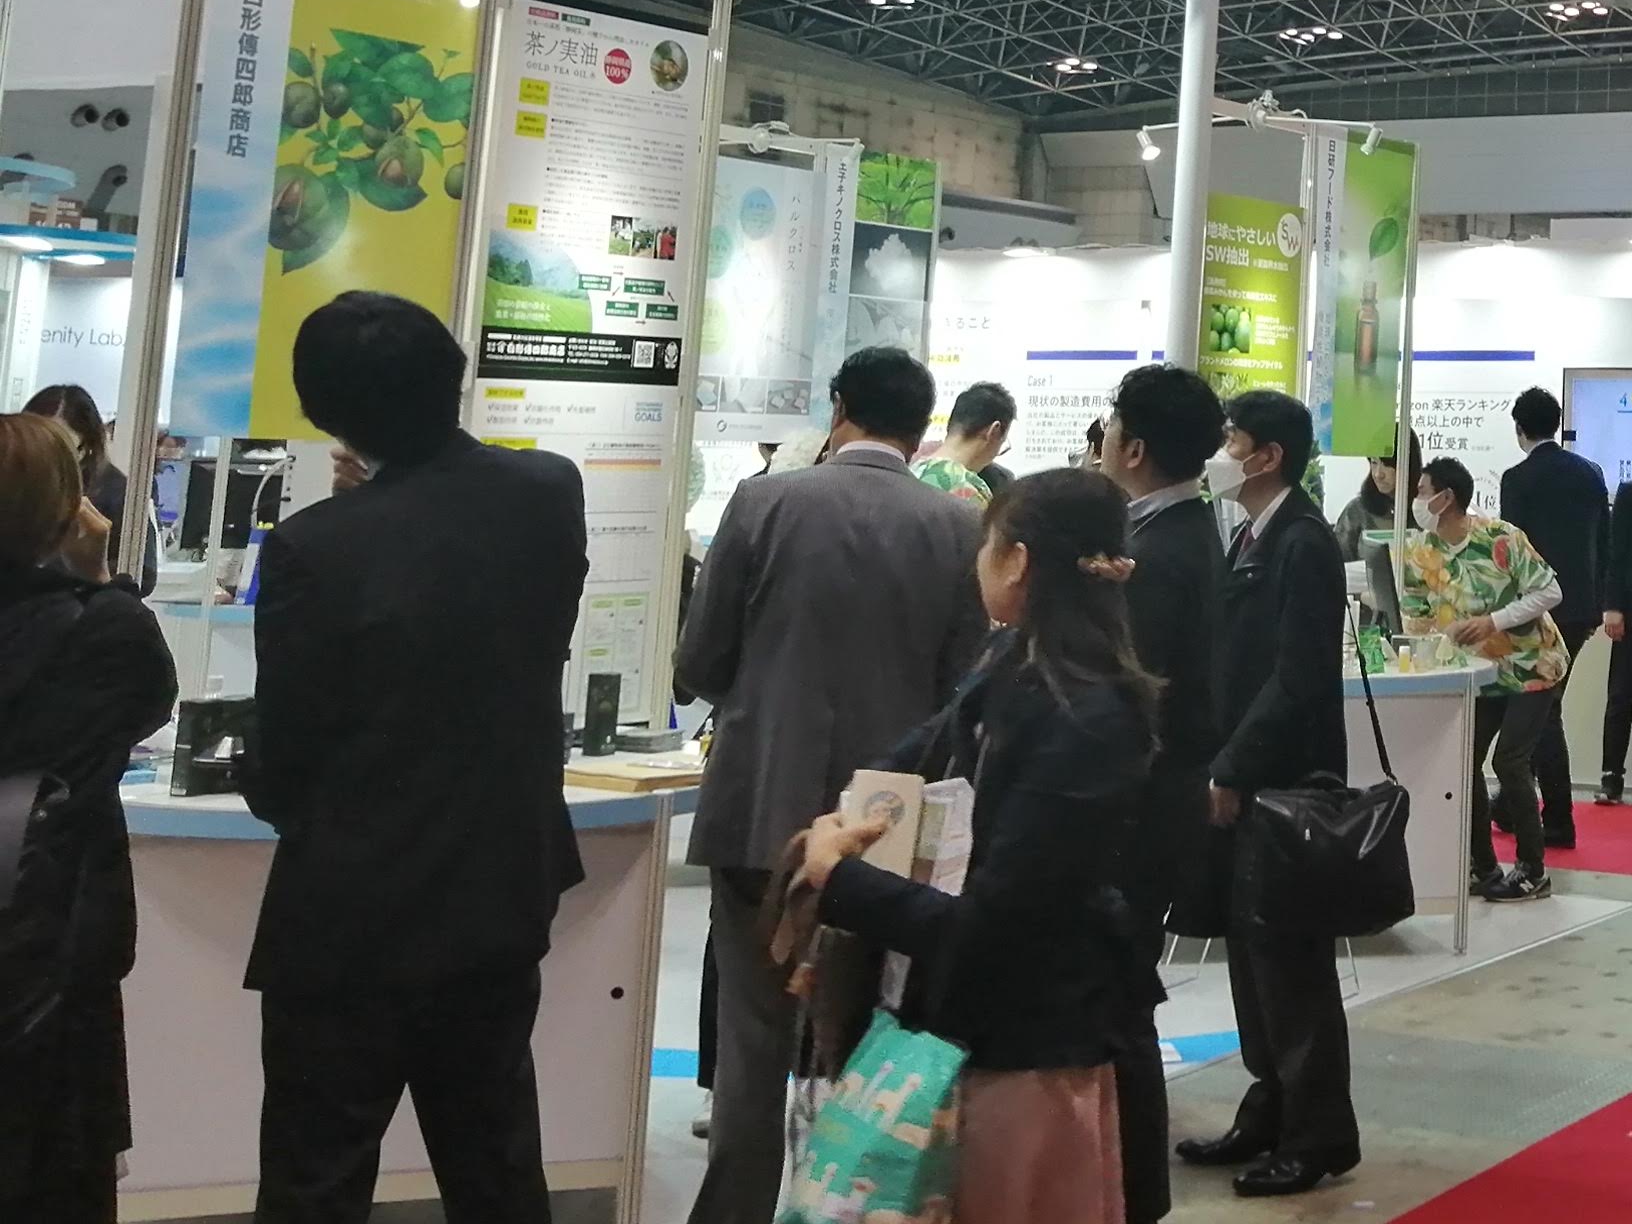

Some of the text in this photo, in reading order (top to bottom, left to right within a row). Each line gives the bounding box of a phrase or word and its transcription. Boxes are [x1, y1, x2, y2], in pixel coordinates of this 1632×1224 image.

[523, 30, 598, 66] 茶ノ実油
[526, 60, 554, 73] GOLD
[554, 65, 570, 75] TEA
[605, 65, 630, 79] 100%
[1207, 221, 1276, 247] 地球にやさしい
[1206, 244, 1249, 267] SW抽出
[1027, 375, 1047, 387] Case
[1431, 398, 1512, 412] 楽天ランキング
[634, 411, 662, 423] GOALS
